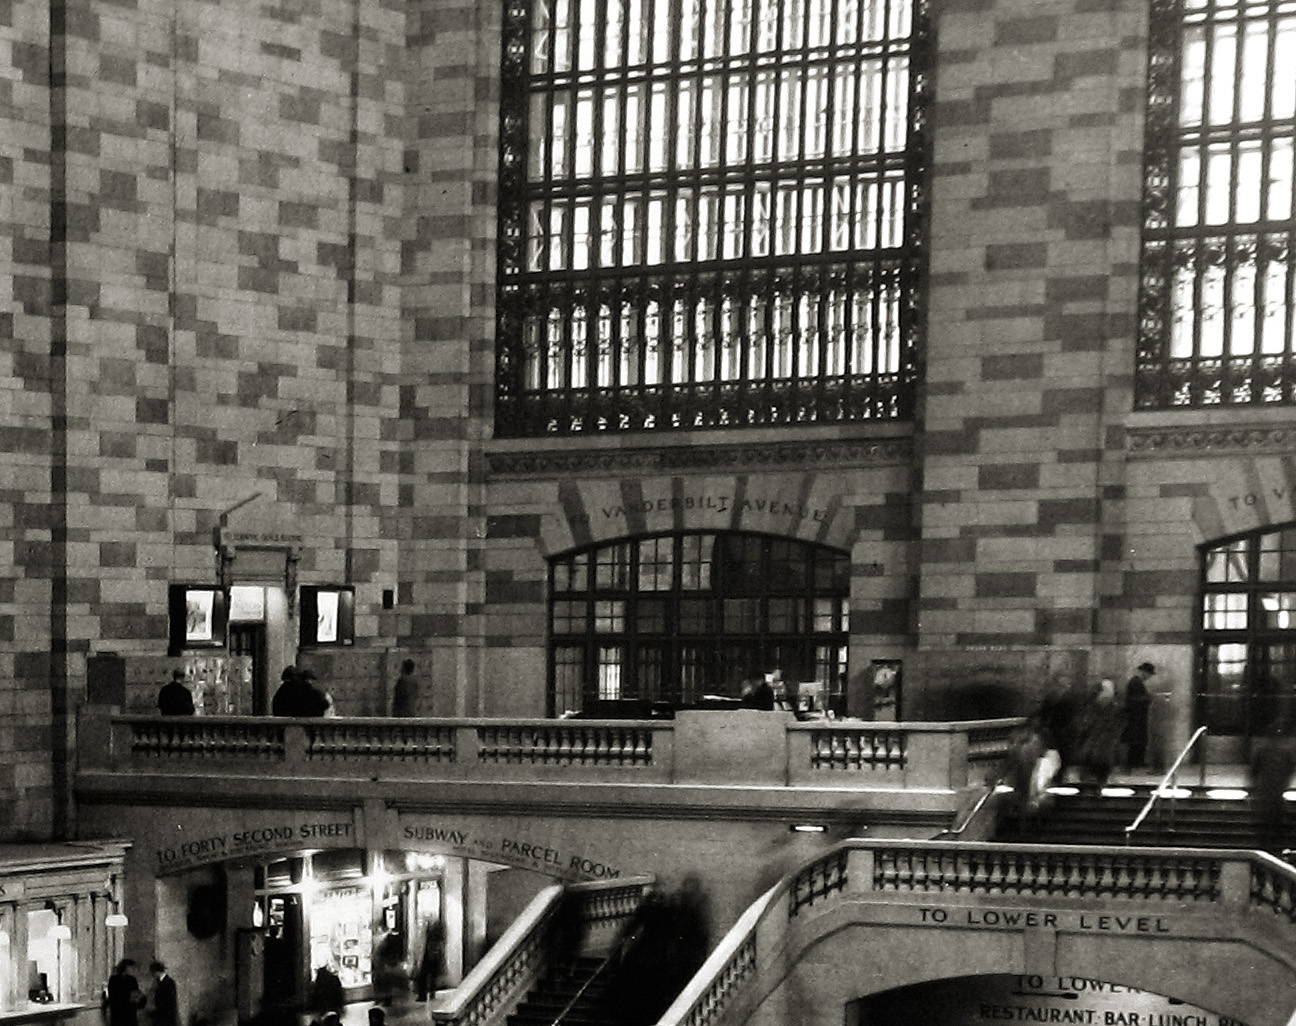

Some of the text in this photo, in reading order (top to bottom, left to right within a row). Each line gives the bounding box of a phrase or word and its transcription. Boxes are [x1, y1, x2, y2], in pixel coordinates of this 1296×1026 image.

[741, 498, 828, 522] AVENUE
[157, 849, 177, 865] TO
[182, 838, 227, 856] FORTY
[233, 824, 293, 846] SECOND
[300, 822, 353, 838] STREET
[404, 826, 469, 845] SUBWAY
[502, 838, 562, 866] PARCEL
[570, 857, 621, 879] ROOM
[919, 908, 1170, 932] TO LOWER LEVEL
